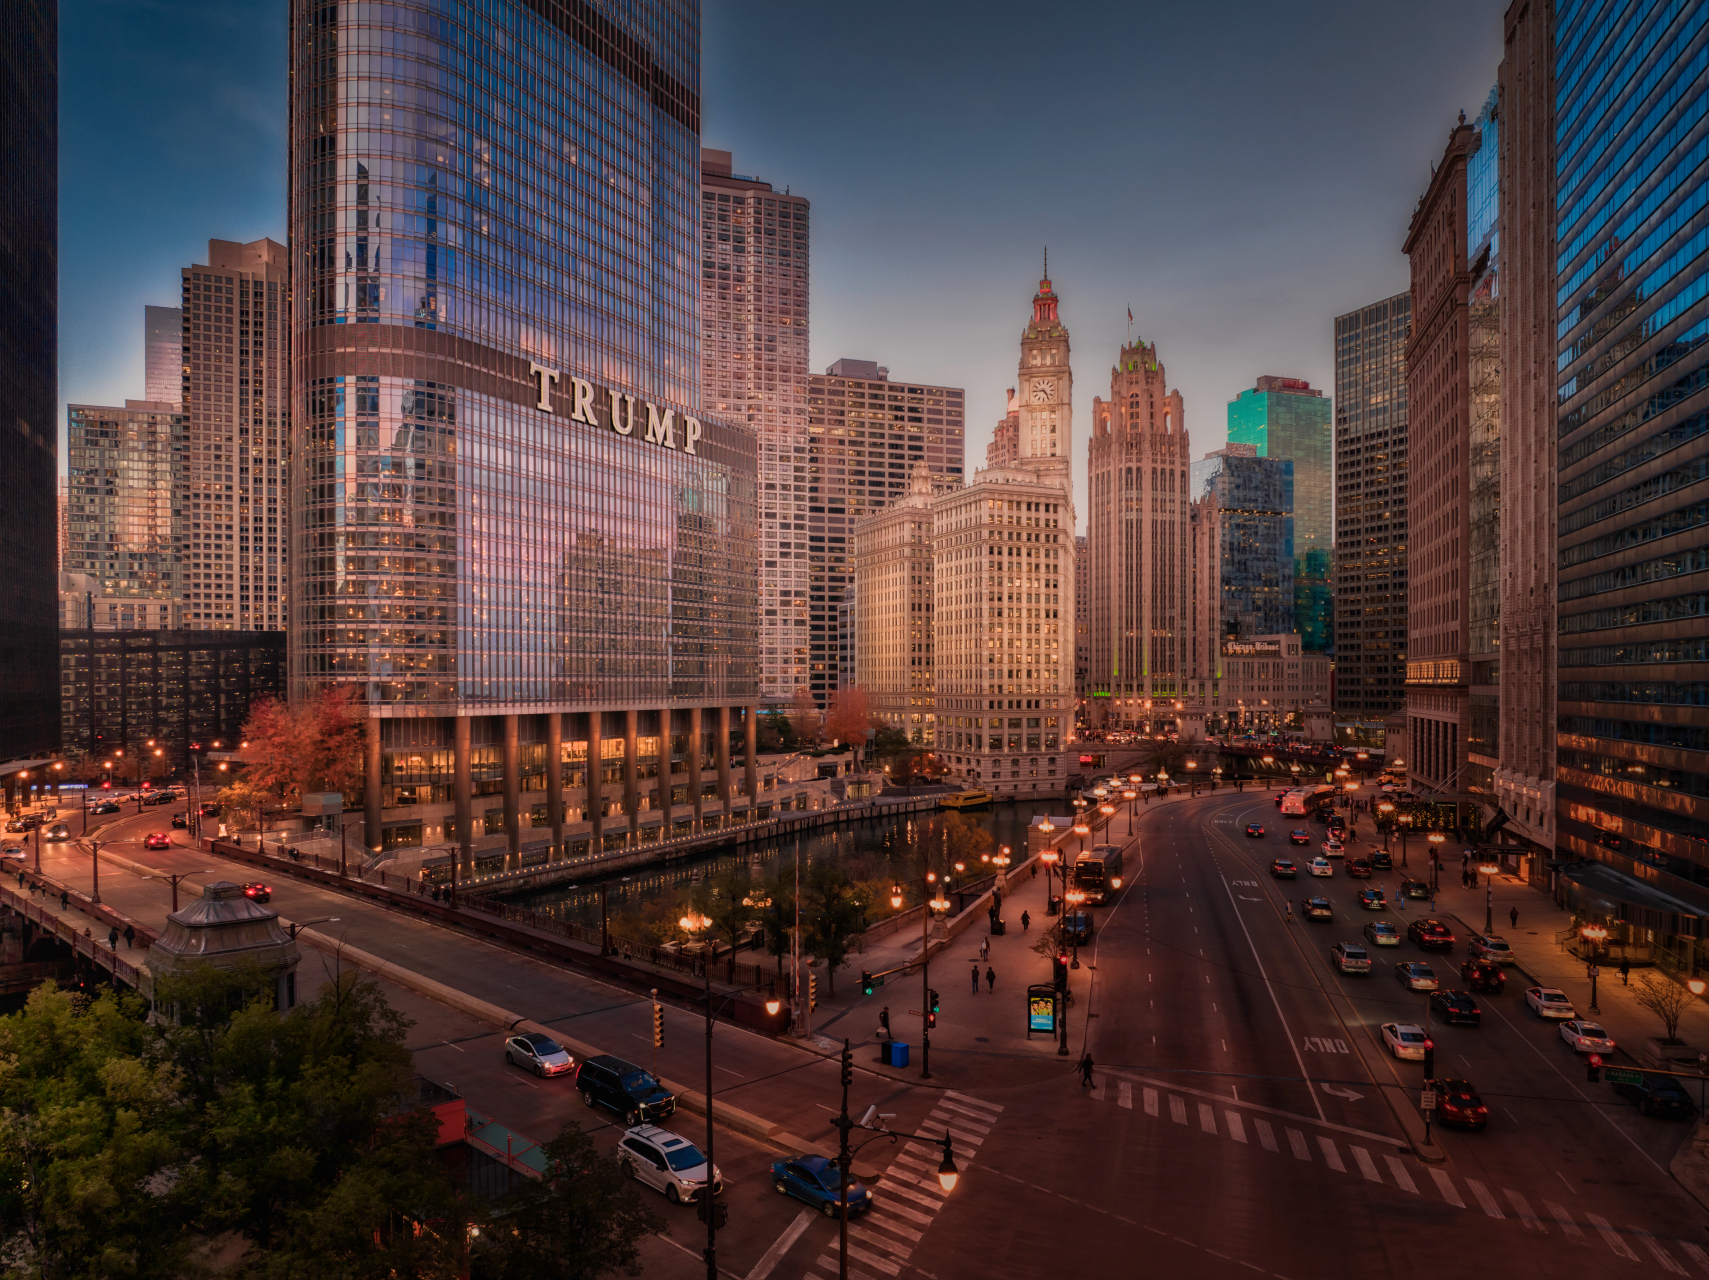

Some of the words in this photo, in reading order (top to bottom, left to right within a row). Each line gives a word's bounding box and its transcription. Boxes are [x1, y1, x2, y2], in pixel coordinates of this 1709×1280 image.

[530, 361, 702, 455] TRUMP
[1227, 642, 1253, 652] Chicago
[1255, 642, 1280, 651] Tribune
[1231, 880, 1258, 888] ONLY
[1303, 1036, 1350, 1054] ONLY
